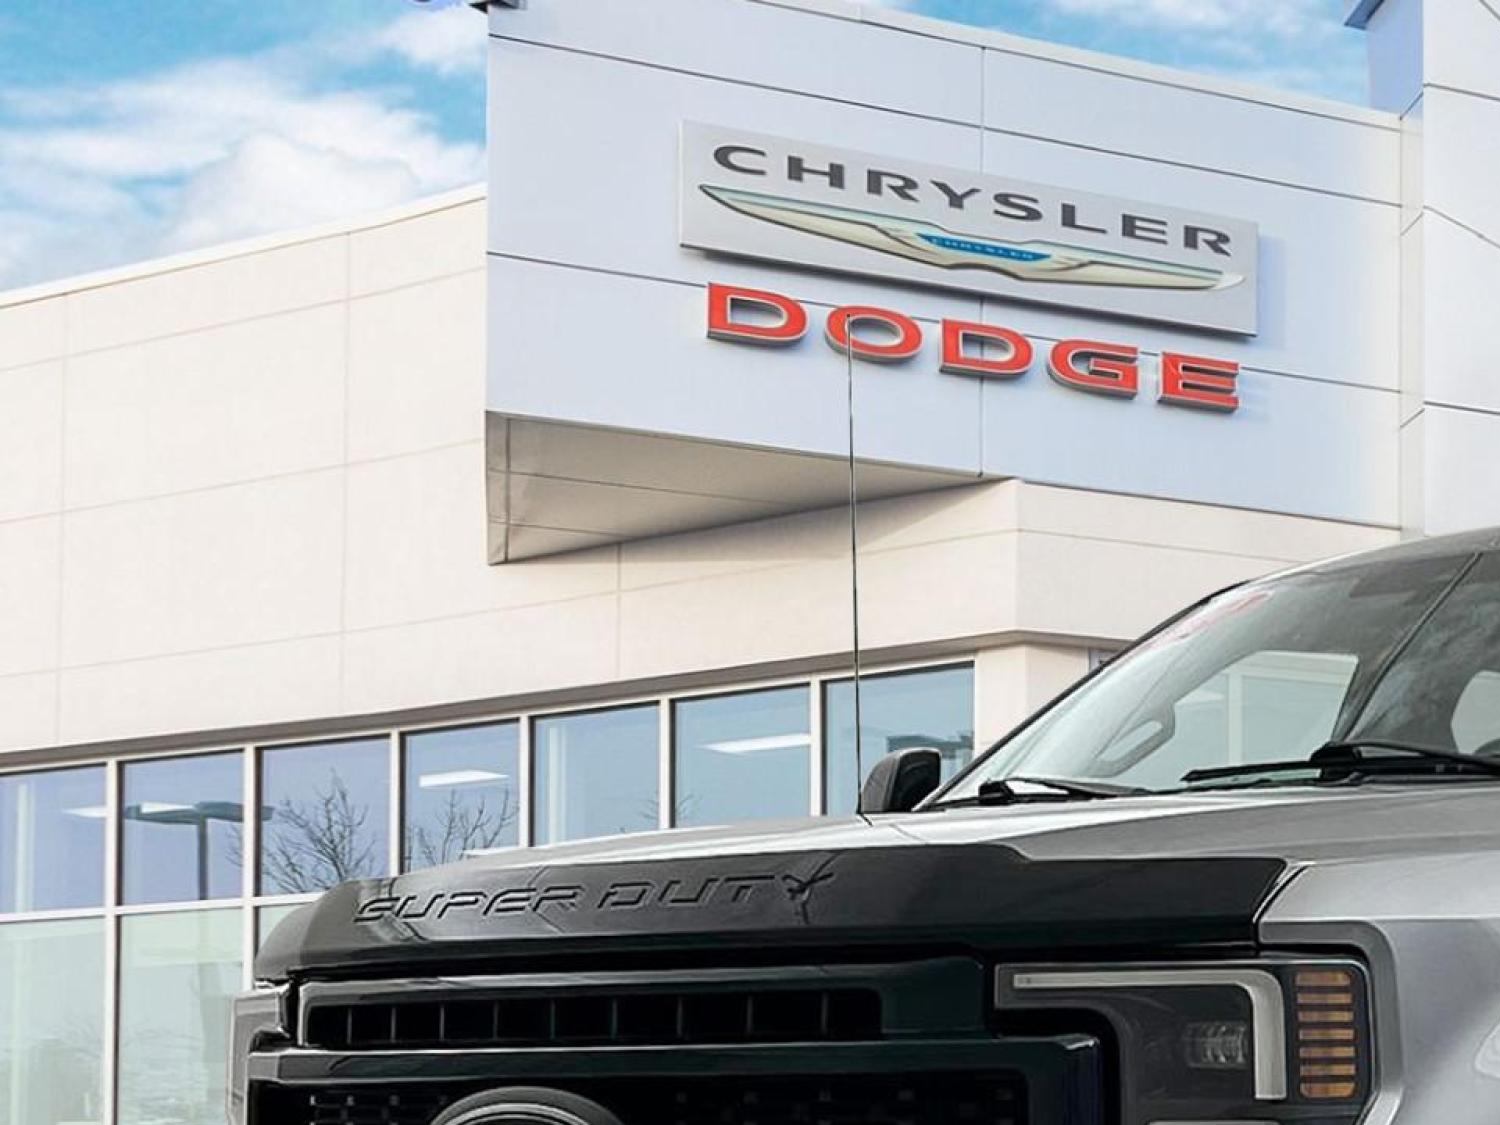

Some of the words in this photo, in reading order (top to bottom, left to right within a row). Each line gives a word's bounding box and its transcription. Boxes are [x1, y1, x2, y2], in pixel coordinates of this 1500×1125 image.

[713, 145, 1231, 257] CHRYSLER
[706, 281, 1240, 414] DODGE
[354, 884, 585, 923] SUPER
[598, 872, 834, 910] DUTY
